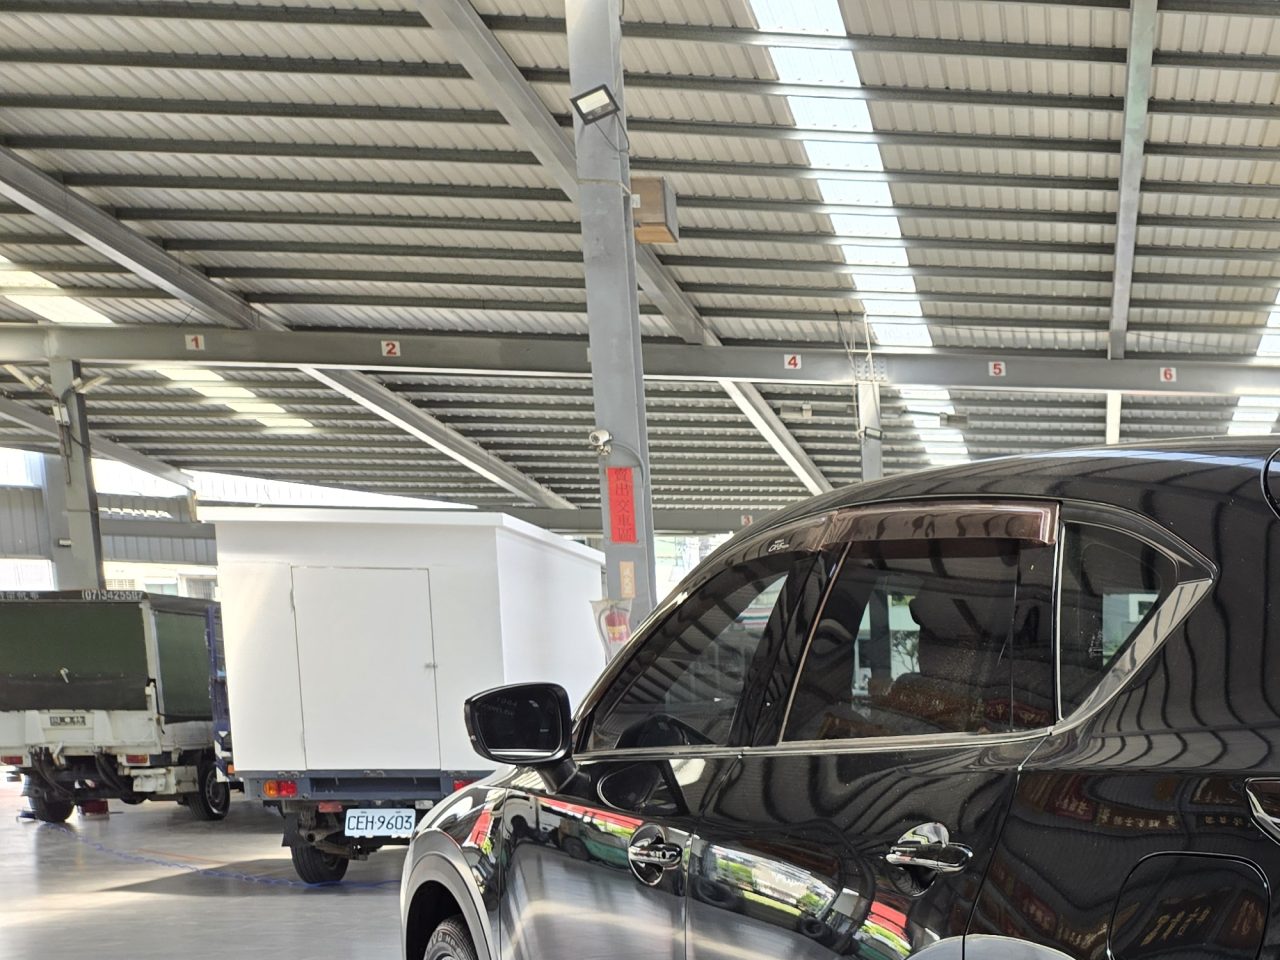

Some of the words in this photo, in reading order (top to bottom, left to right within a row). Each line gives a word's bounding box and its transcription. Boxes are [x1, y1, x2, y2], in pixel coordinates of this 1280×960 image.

[191, 335, 200, 349] 1
[385, 342, 397, 356] 2
[787, 355, 798, 368] 4
[993, 363, 1002, 375] 5
[1164, 368, 1173, 381] 6
